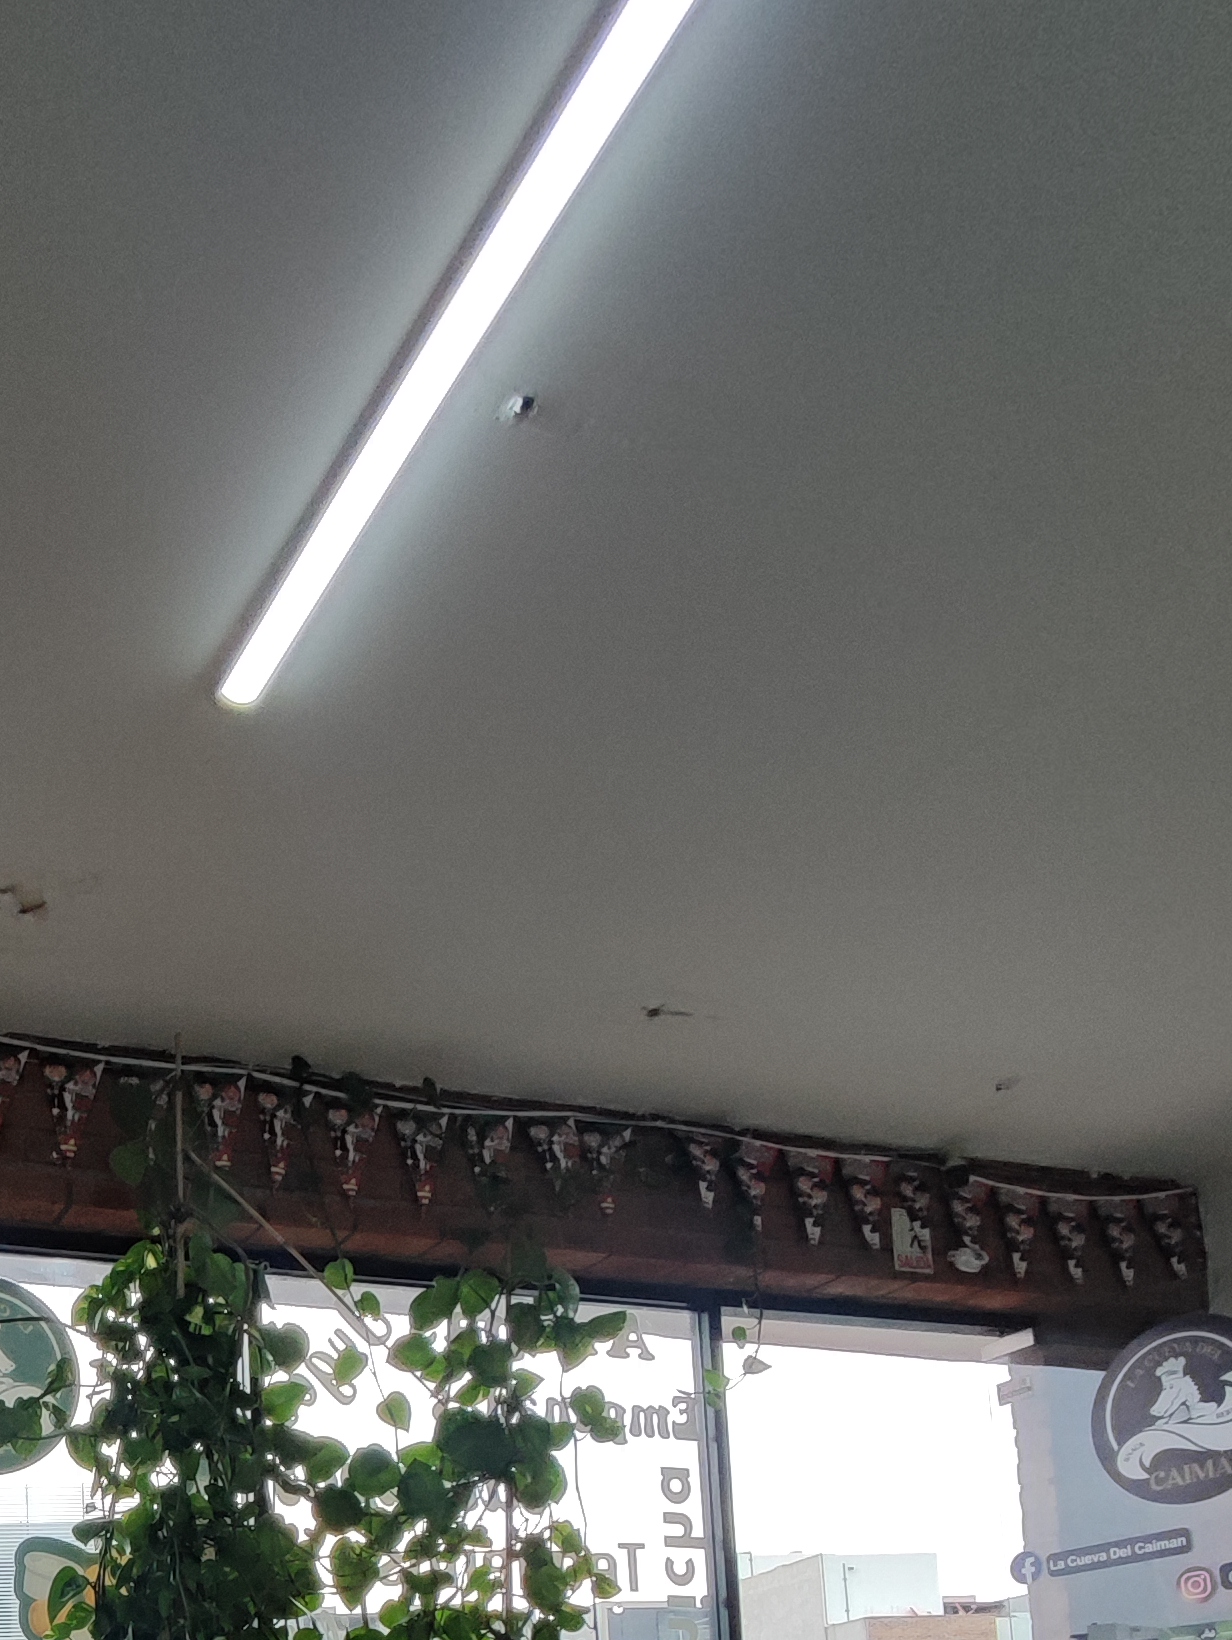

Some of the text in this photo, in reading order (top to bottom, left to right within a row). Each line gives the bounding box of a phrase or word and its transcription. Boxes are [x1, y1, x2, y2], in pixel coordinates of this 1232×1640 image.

[1048, 1534, 1187, 1572] La Cueva Del Caiman
